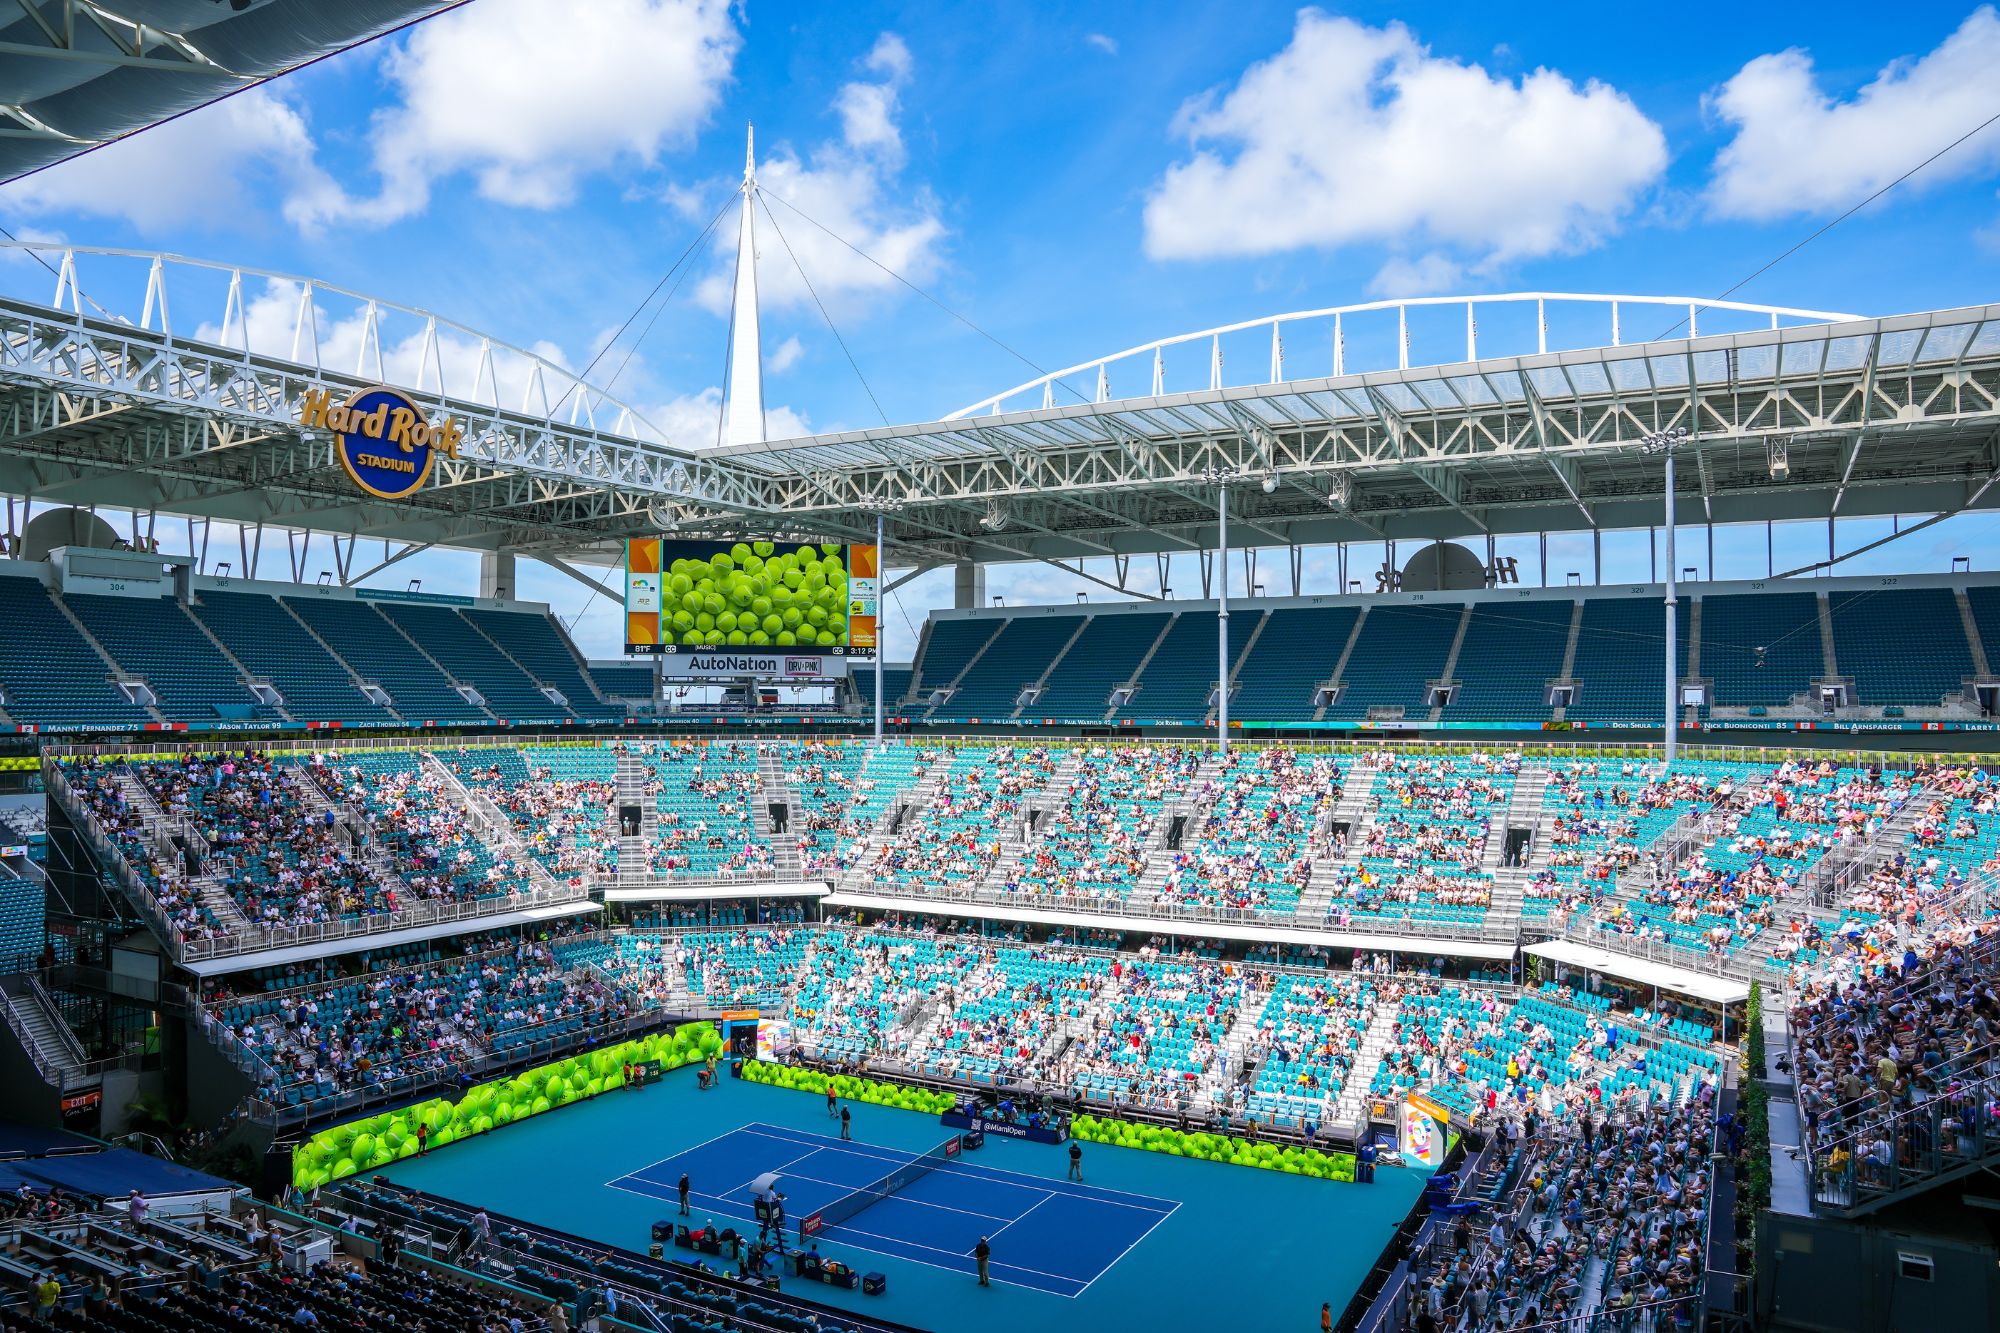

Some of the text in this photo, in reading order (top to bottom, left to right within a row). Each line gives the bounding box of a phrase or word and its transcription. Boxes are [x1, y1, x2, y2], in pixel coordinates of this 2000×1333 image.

[301, 388, 462, 460] Hard Rock
[357, 453, 415, 473] STADIUM
[110, 583, 125, 591] 304
[1751, 582, 1765, 590] 321
[1881, 578, 1897, 586] 322
[689, 656, 777, 671] AutoNation
[71, 1096, 87, 1107] EXIT
[983, 1122, 1026, 1136] @MiamiOpen
